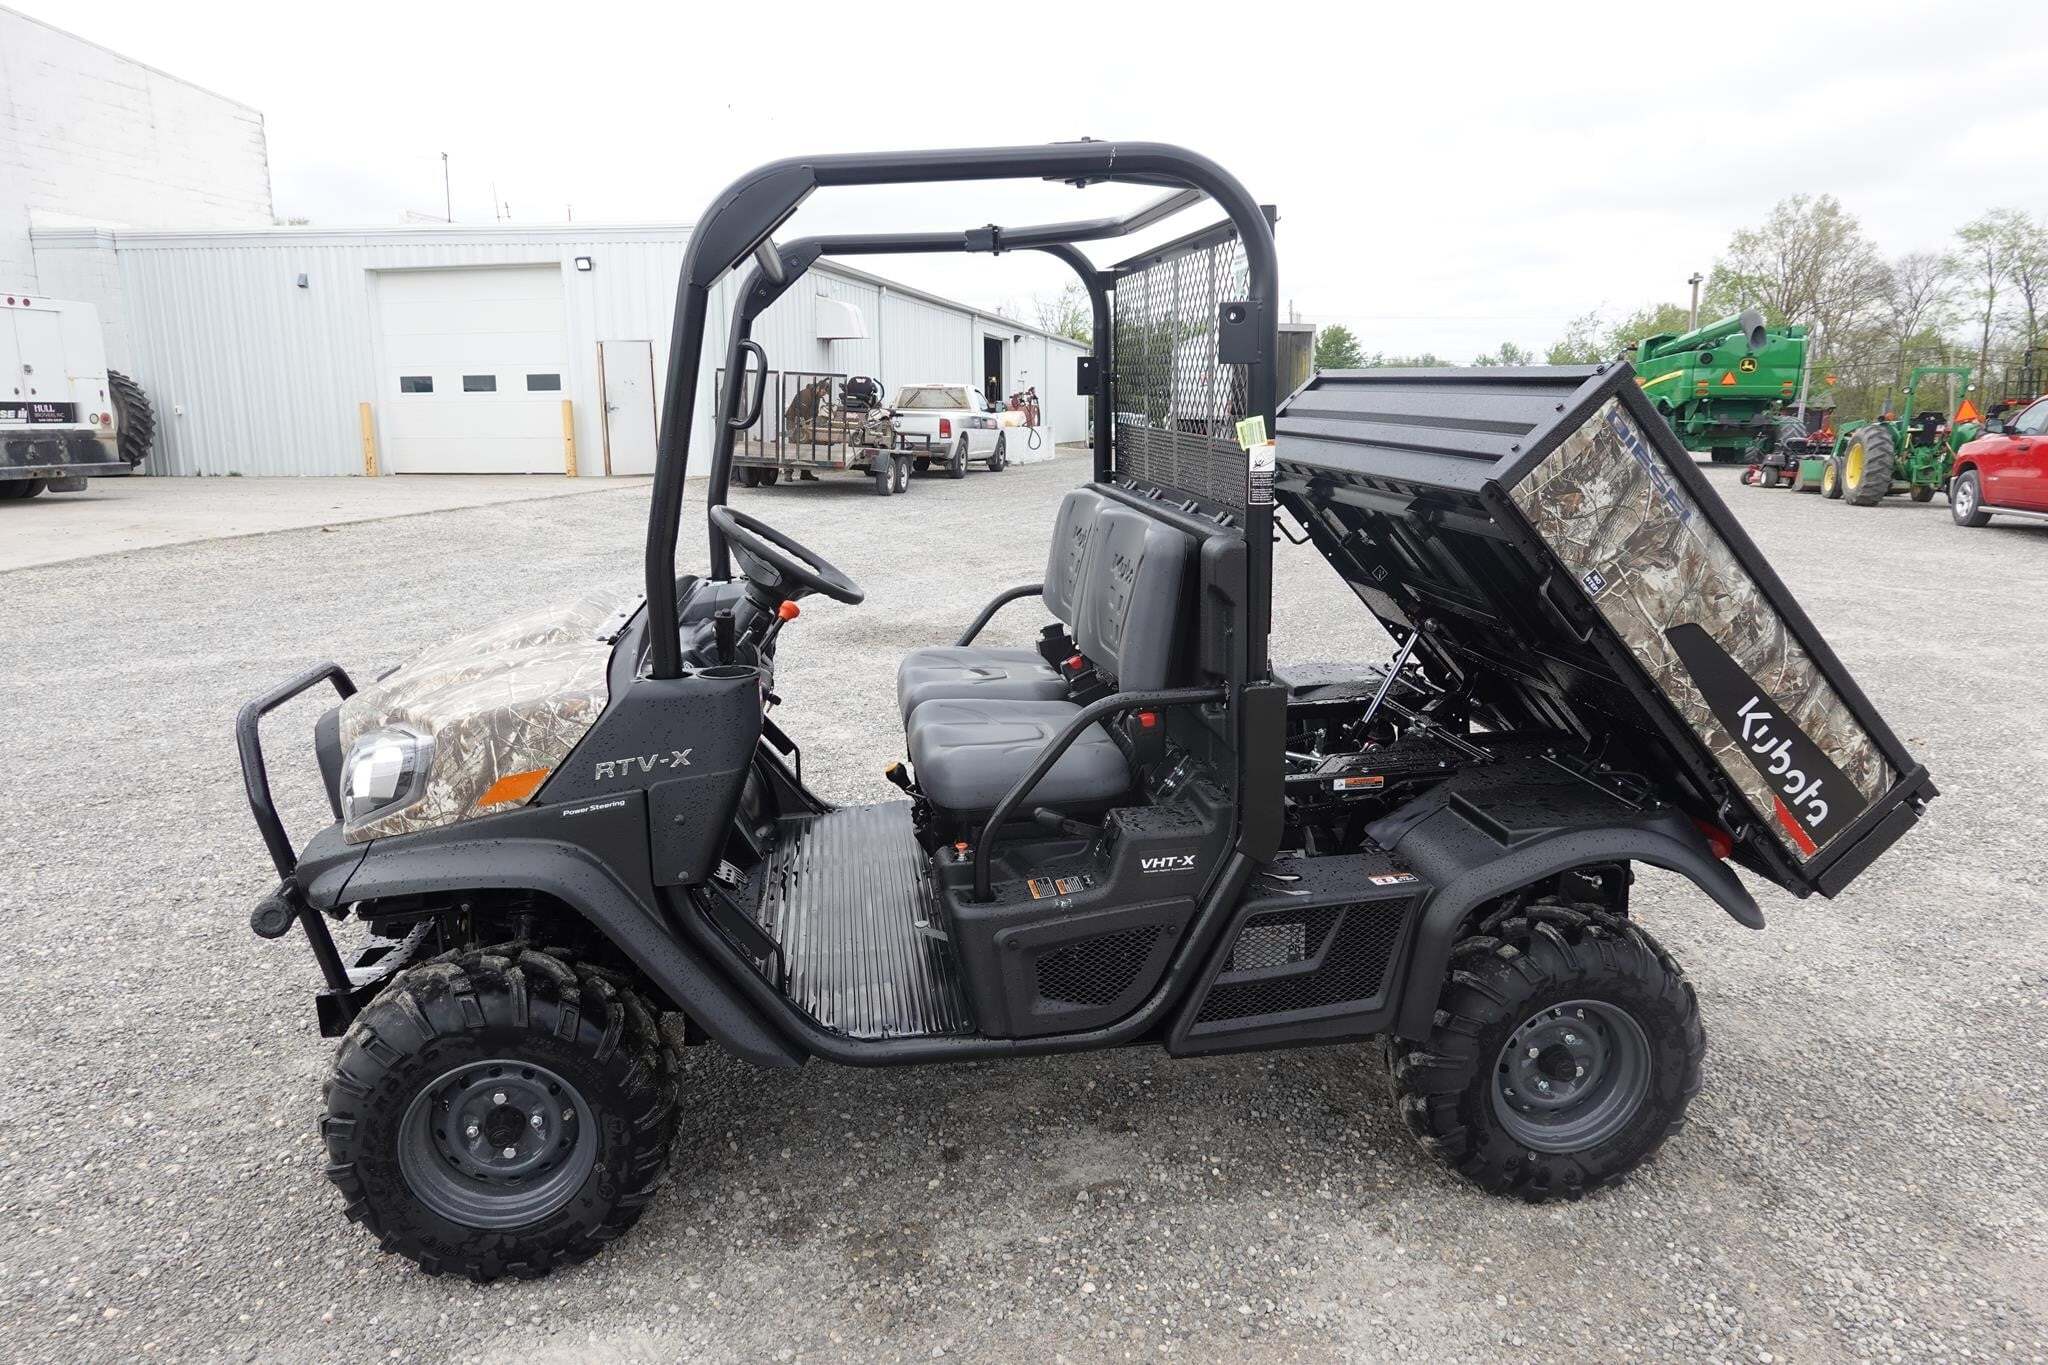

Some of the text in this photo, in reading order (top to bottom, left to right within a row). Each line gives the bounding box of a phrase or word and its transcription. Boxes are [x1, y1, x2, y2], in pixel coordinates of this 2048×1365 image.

[1586, 577, 1598, 590] STEP
[1593, 575, 1601, 584] NO
[595, 749, 692, 780] RTV-X
[1737, 695, 1829, 827] Kubota
[562, 799, 626, 817] Power Steering
[1141, 854, 1196, 869] VHT-X
